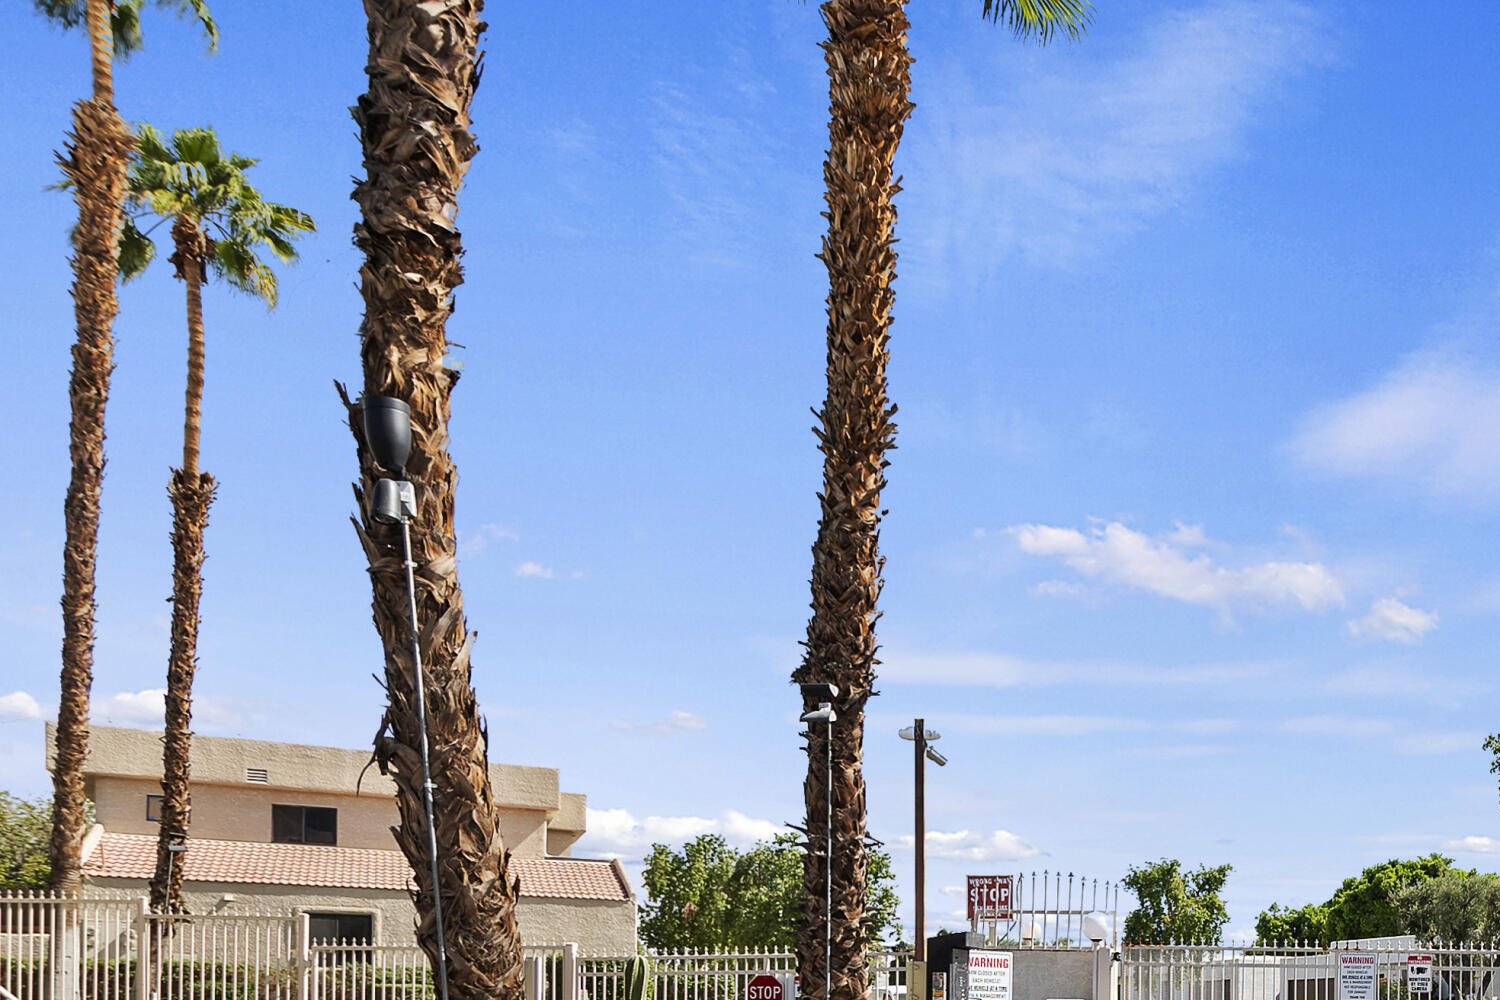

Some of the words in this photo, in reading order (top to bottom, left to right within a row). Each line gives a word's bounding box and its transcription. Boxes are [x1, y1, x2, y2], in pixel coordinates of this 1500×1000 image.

[970, 888, 1009, 902] STOP
[1341, 956, 1374, 965] WARNING
[749, 986, 781, 999] STOP
